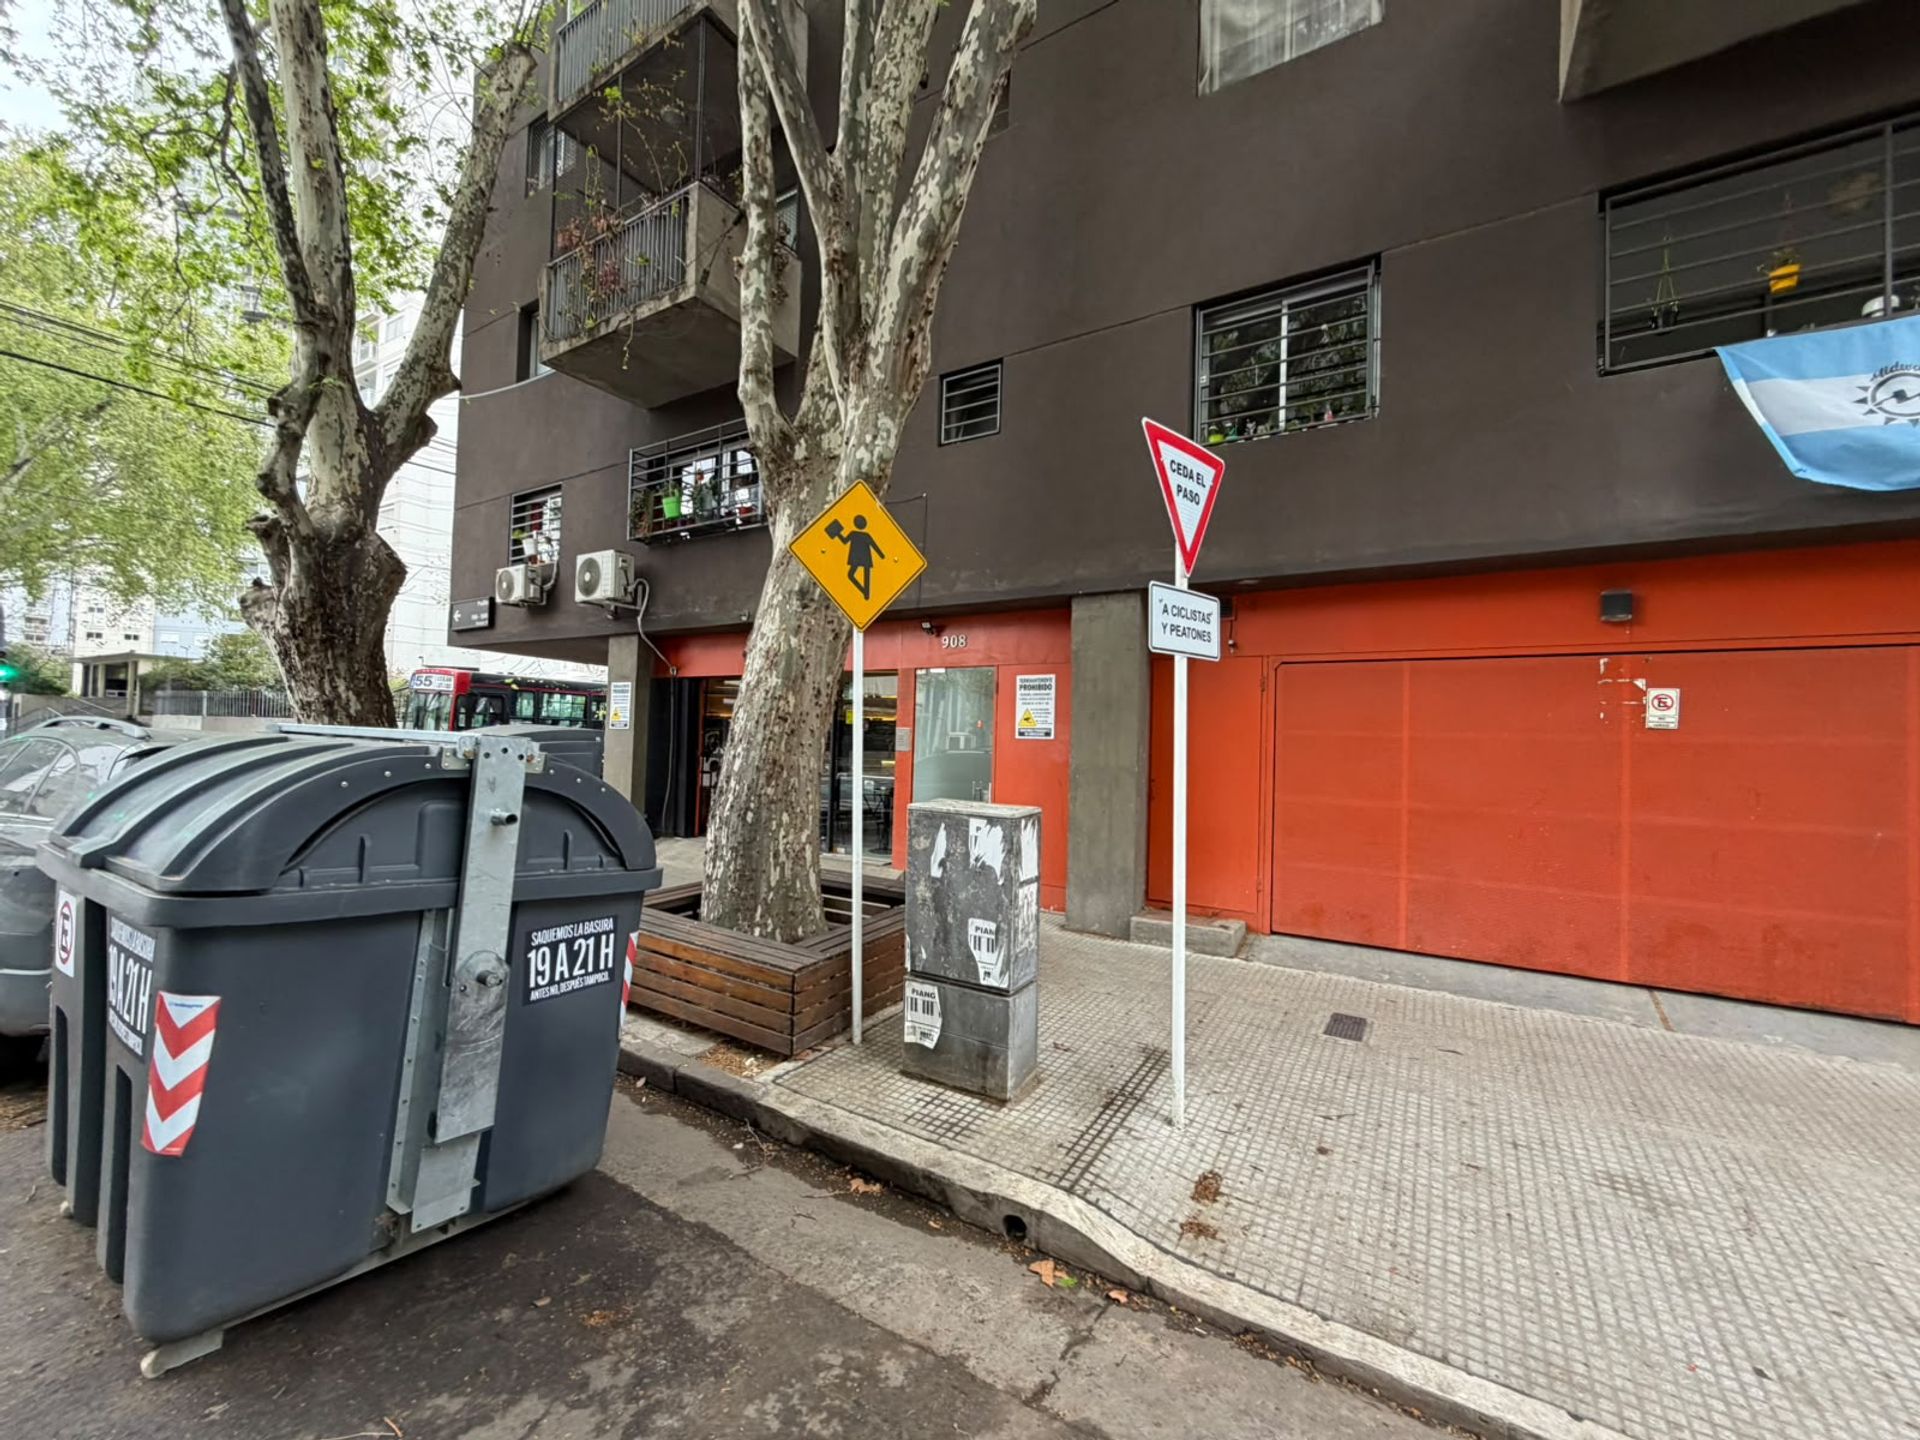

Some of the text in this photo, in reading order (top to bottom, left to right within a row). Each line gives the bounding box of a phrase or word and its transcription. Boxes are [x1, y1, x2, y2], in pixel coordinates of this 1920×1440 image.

[1170, 459, 1206, 488] CEDA EL
[1177, 484, 1200, 505] PASO
[1162, 602, 1211, 624] A CICLISTAS
[942, 635, 966, 648] 908
[1161, 622, 1211, 643] Y PEATONES
[416, 676, 433, 687] 55
[531, 917, 614, 947] SAQUEMOS LA BASURA
[527, 933, 615, 989] 19 A 21 H
[123, 957, 139, 1026] 21
[137, 966, 152, 1035] H
[530, 986, 550, 1001] ANTES
